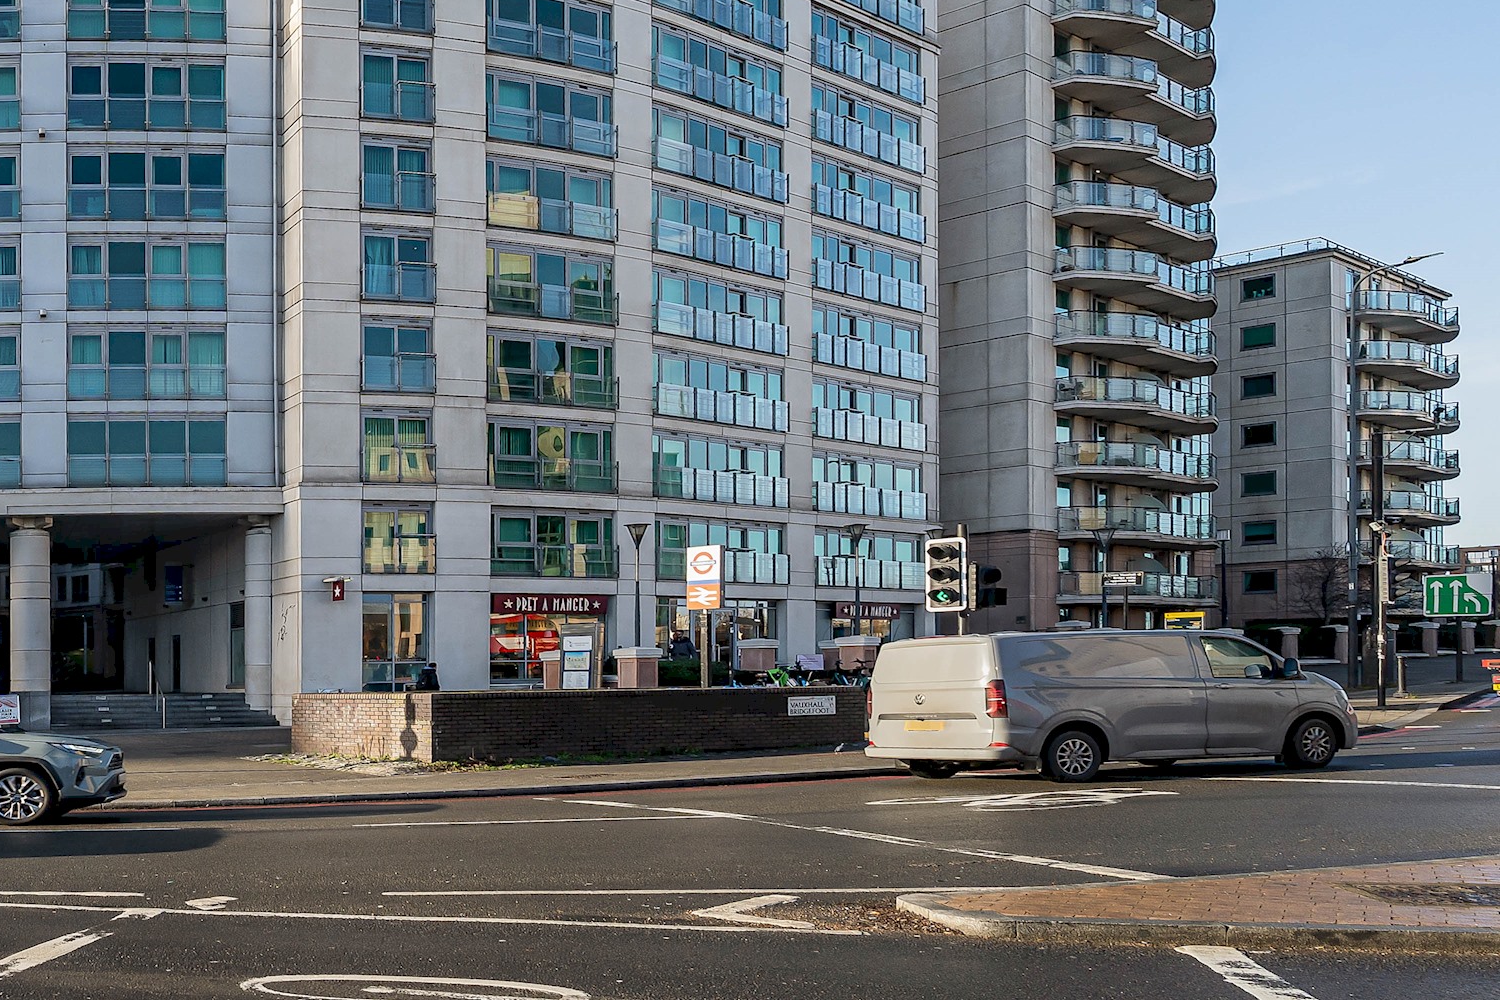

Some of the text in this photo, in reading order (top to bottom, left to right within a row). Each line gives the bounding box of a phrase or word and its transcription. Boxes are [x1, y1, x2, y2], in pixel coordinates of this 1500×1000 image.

[516, 596, 590, 612] PRET A MANGER
